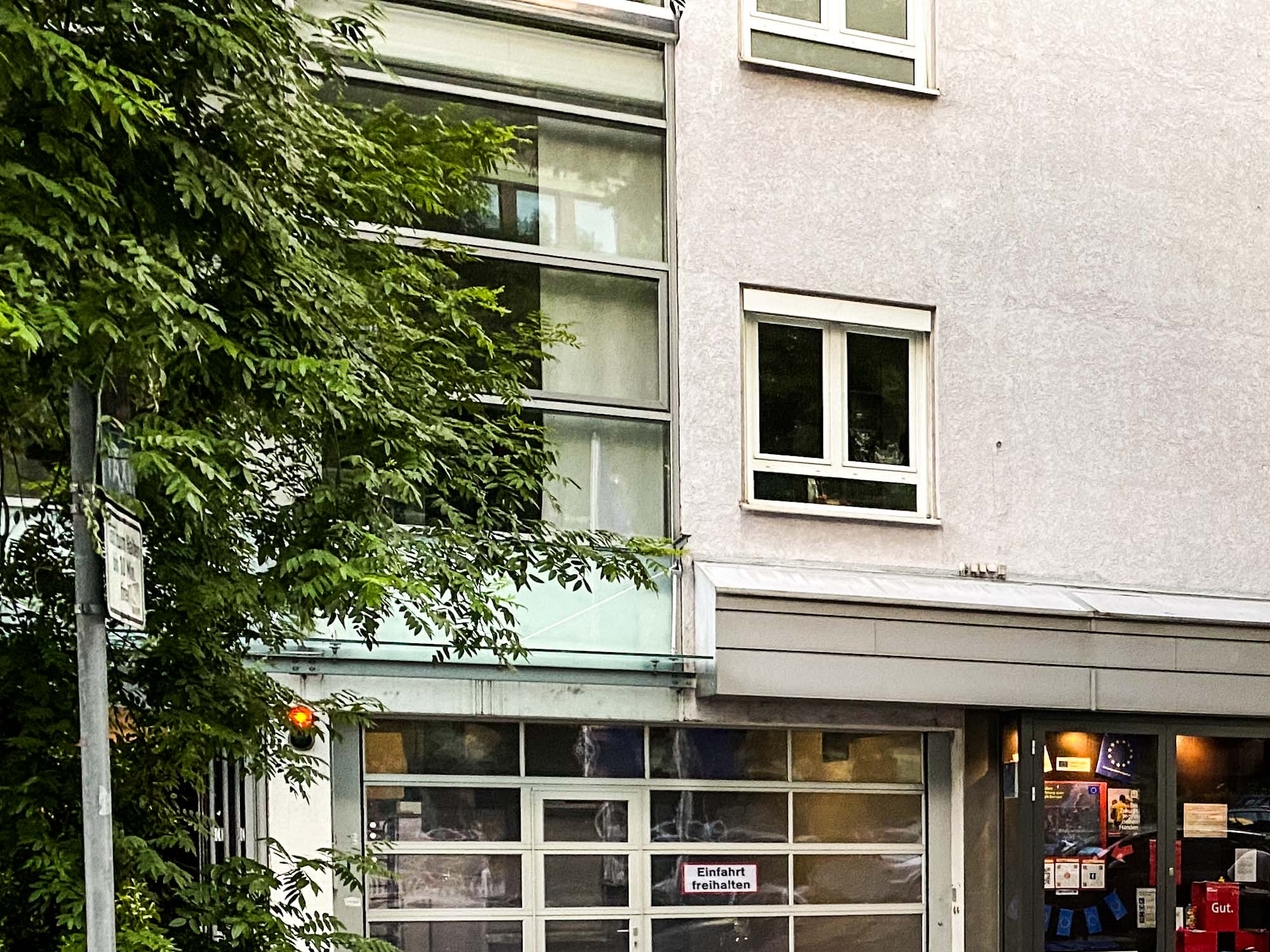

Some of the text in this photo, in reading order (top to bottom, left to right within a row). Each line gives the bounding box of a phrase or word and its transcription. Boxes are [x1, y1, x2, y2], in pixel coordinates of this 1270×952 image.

[697, 867, 745, 877] Einfahrt
[692, 880, 751, 890] freihalten
[1211, 902, 1234, 914] Gut.
